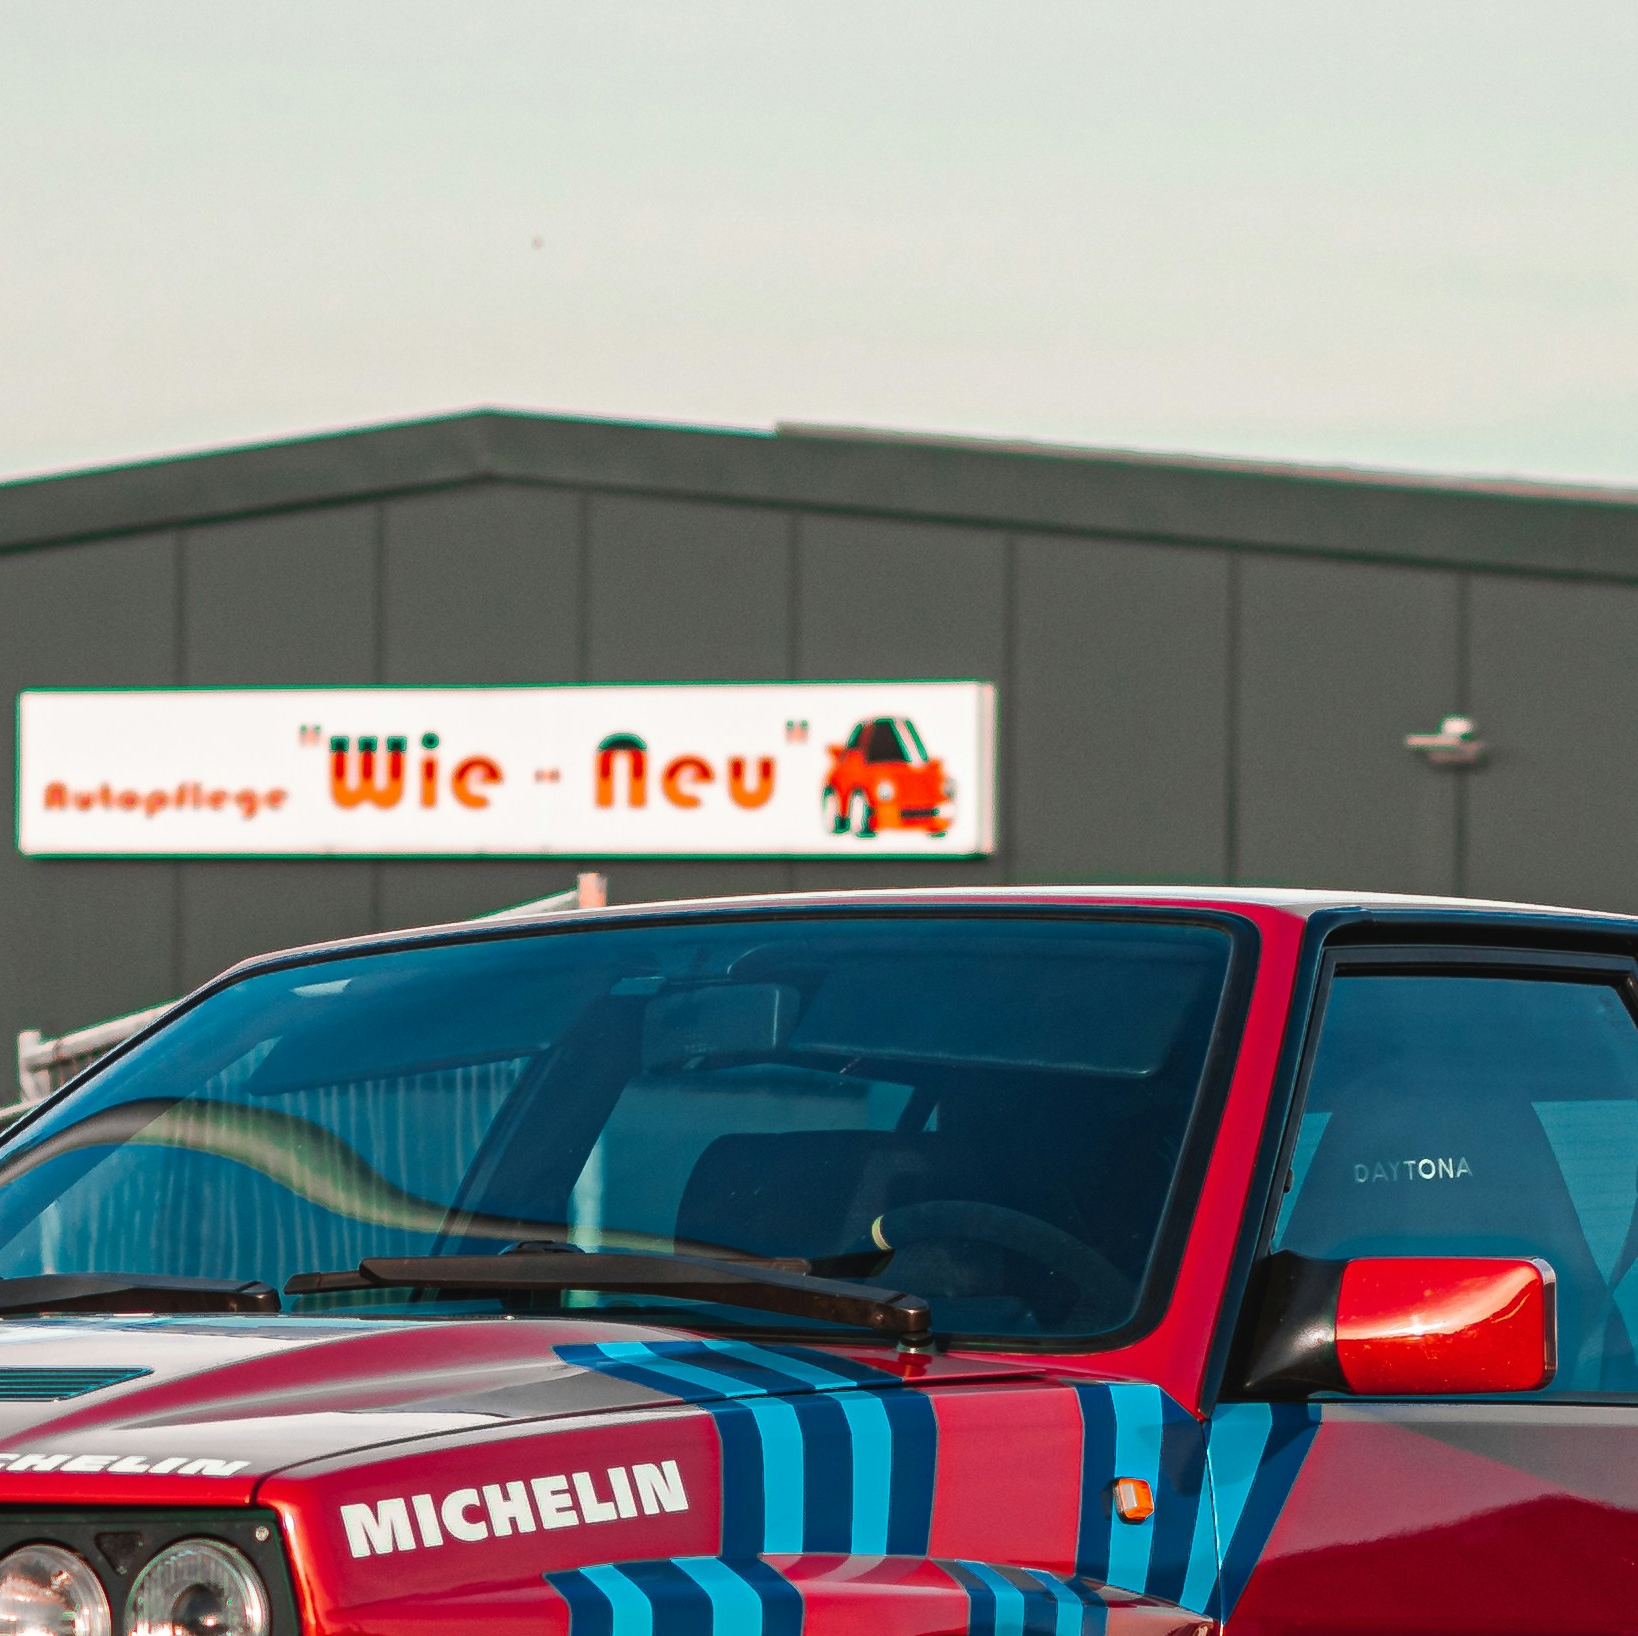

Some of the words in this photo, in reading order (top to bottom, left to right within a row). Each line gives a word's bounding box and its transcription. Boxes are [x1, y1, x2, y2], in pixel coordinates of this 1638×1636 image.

[43, 781, 287, 819] Autopflege
[1354, 1157, 1473, 1182] DAYTONA
[340, 1460, 689, 1558] MICHELIN
